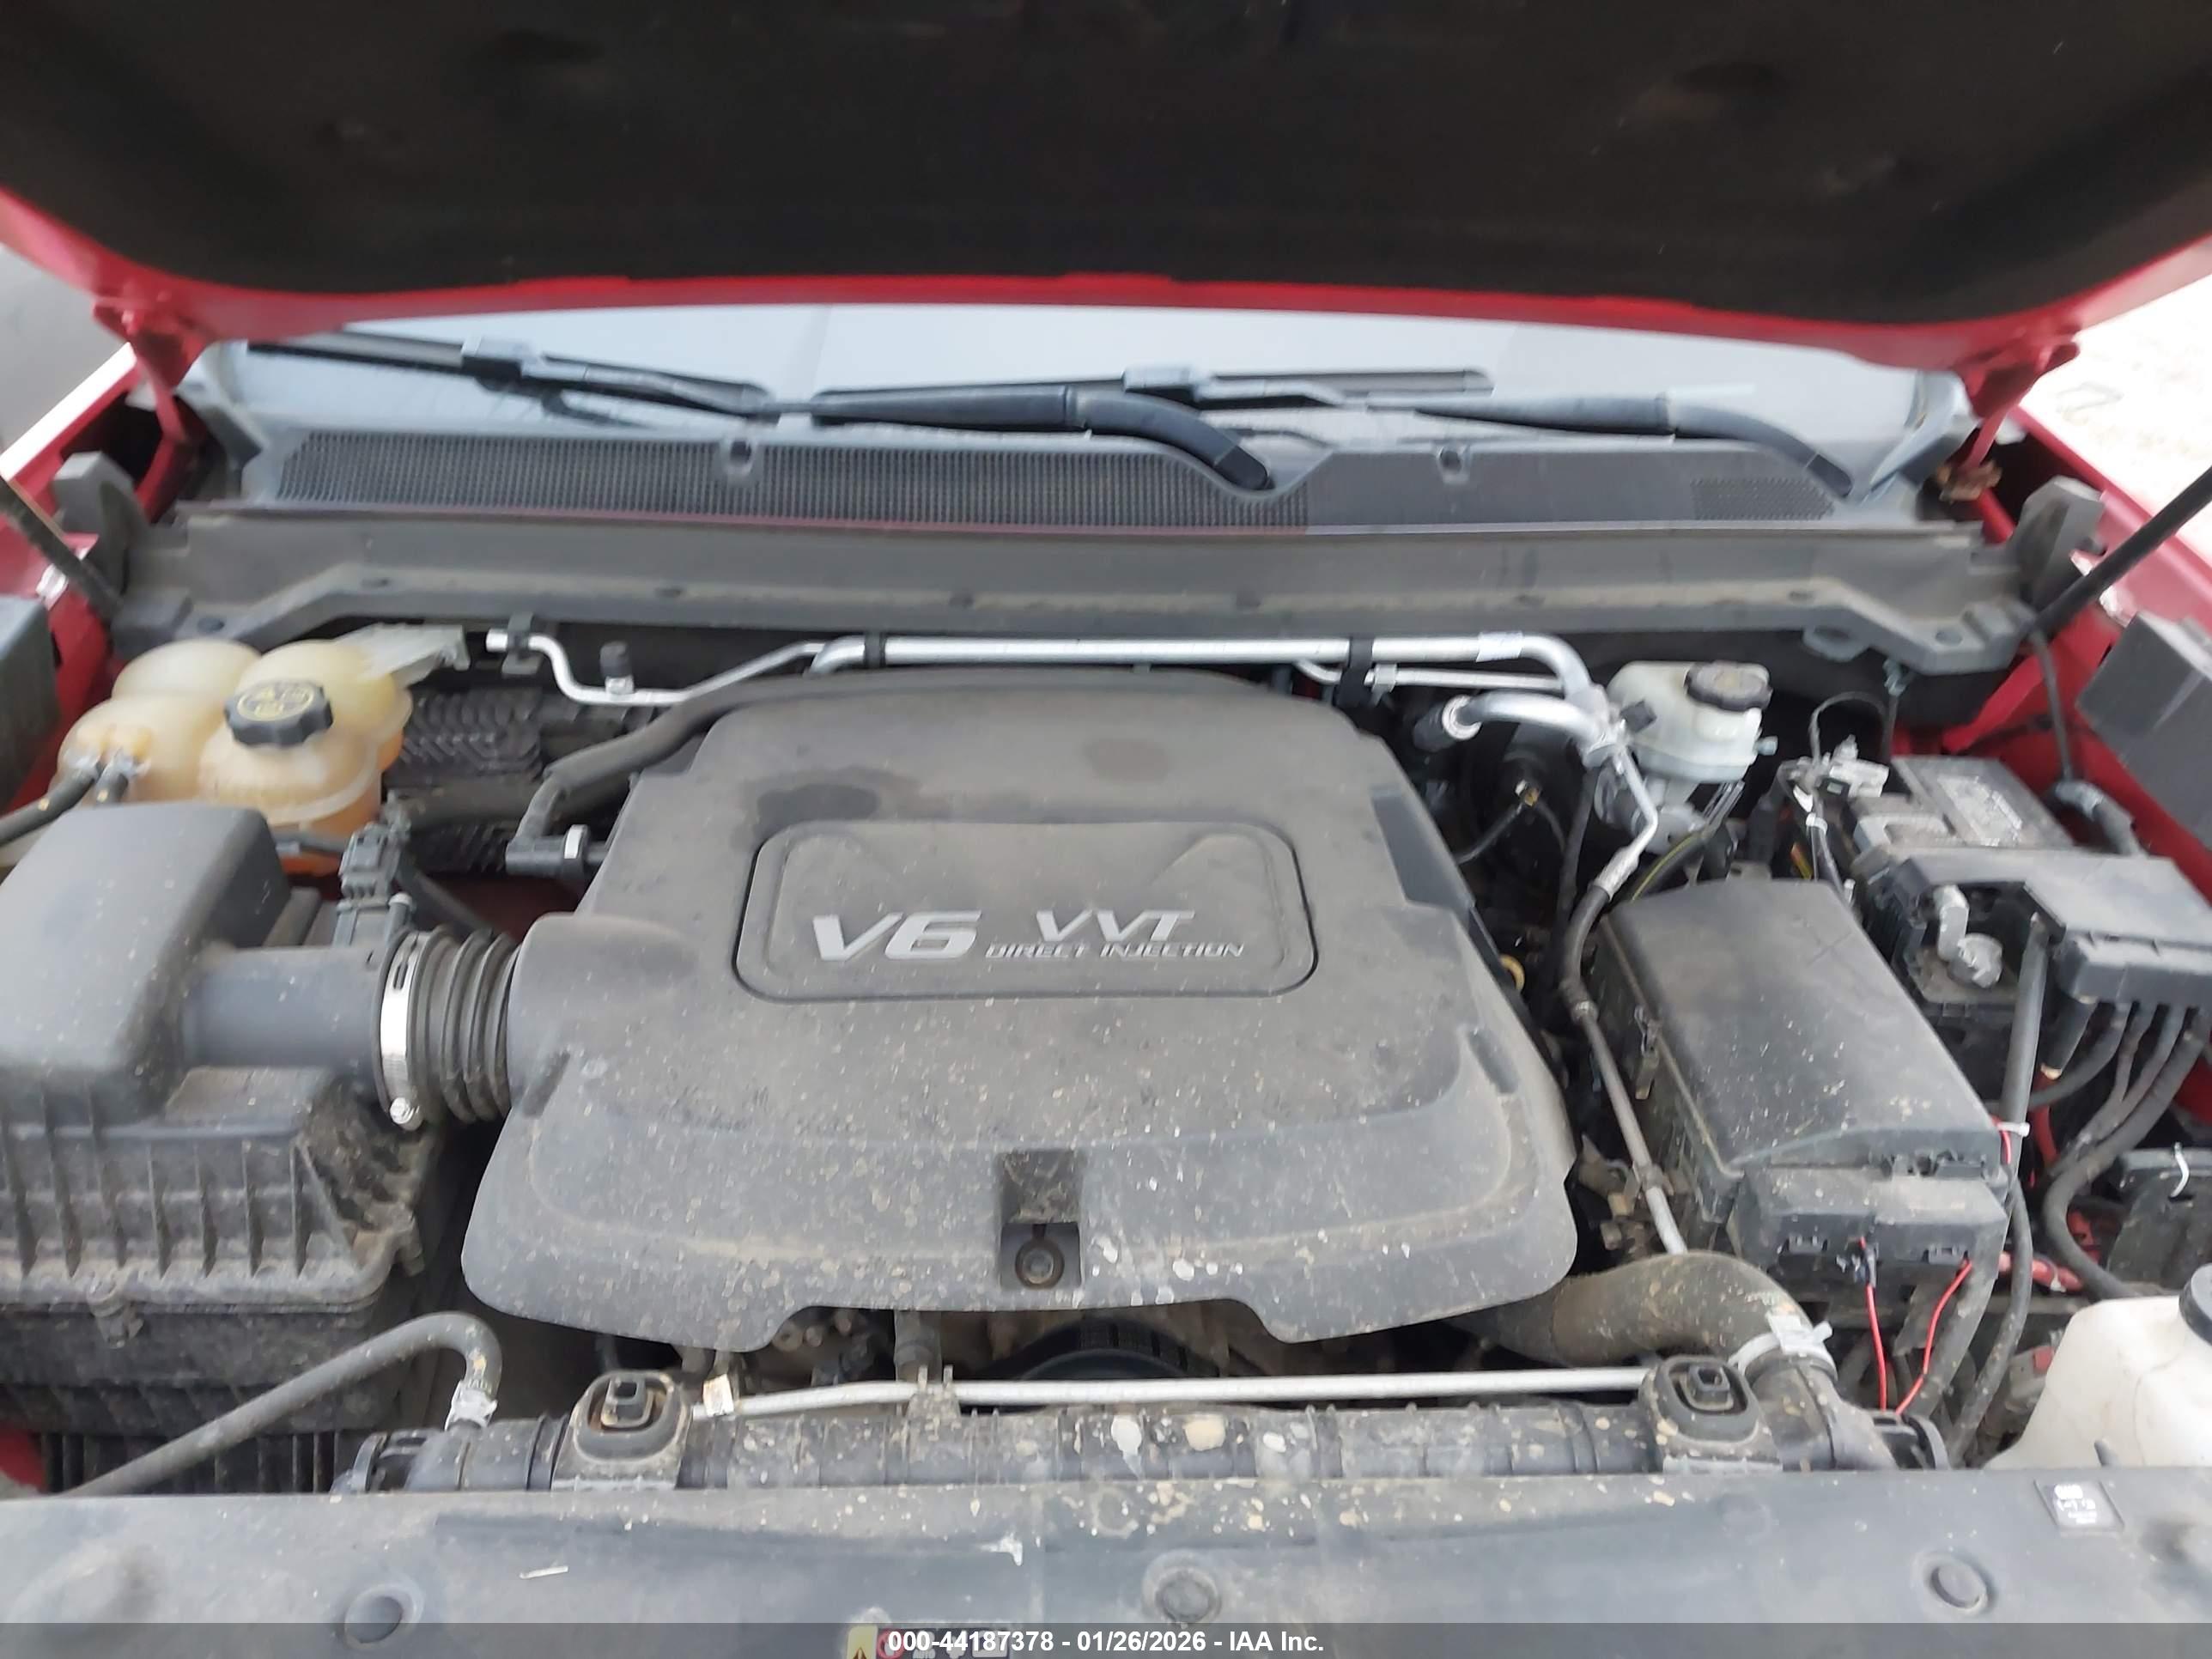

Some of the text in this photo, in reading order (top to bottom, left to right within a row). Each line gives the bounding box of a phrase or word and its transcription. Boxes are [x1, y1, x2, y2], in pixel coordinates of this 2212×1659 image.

[813, 910, 1195, 961] V6 VVT
[985, 943, 1244, 958] DIRECT INJECTION
